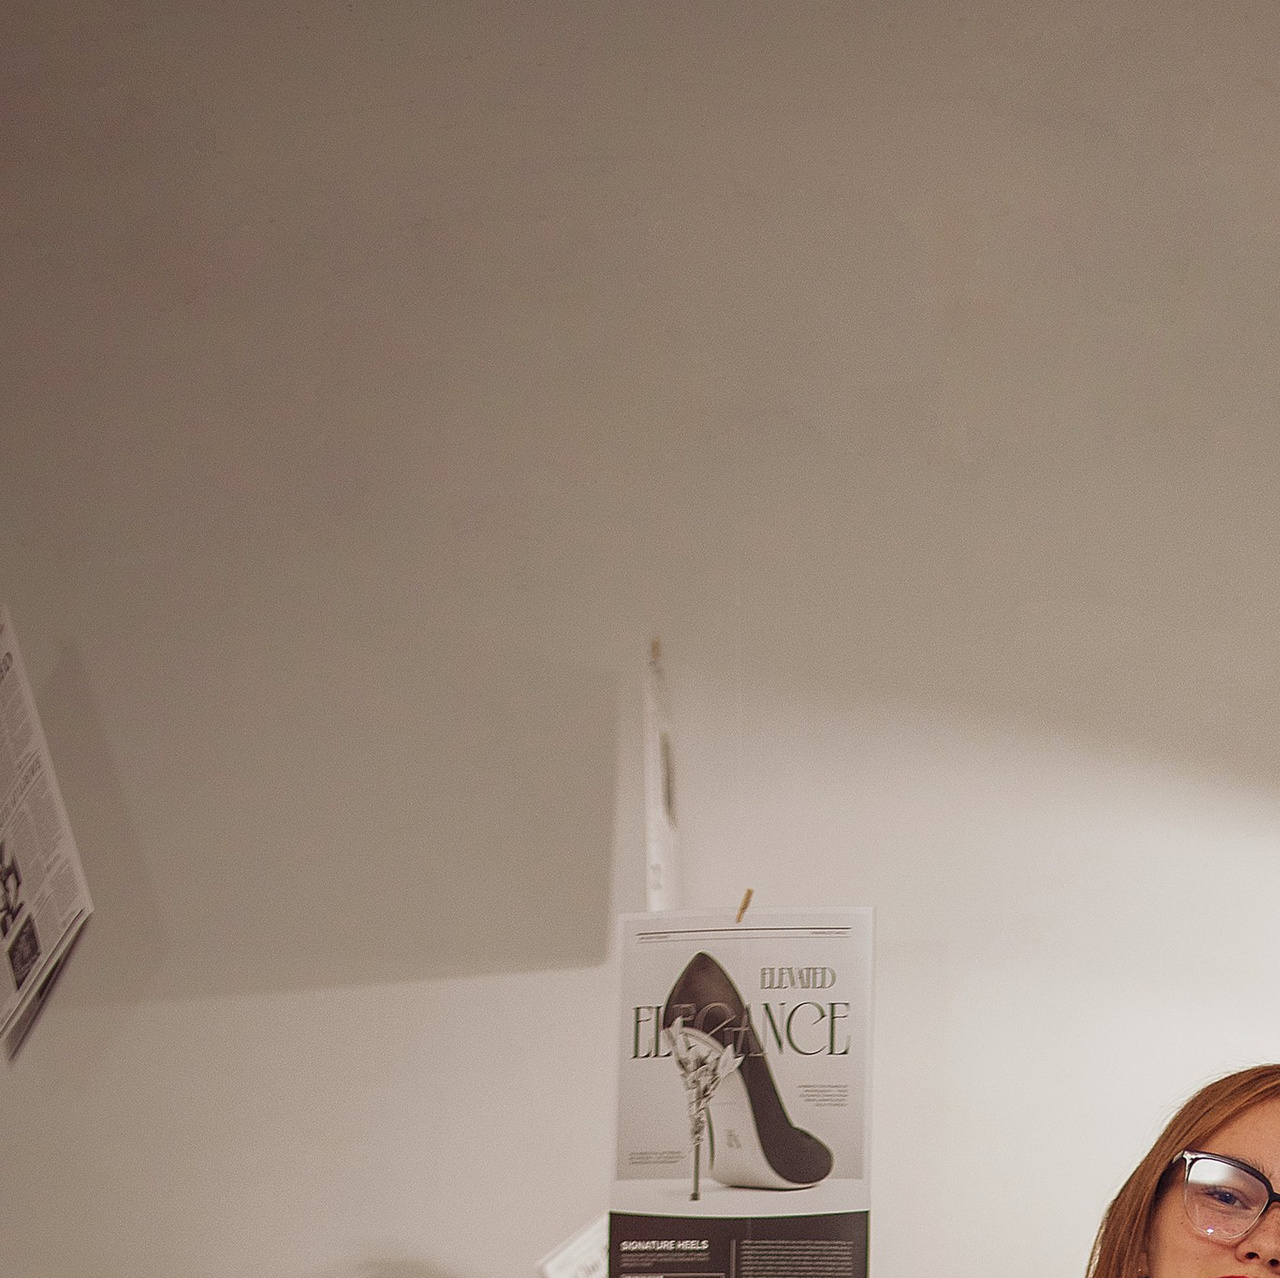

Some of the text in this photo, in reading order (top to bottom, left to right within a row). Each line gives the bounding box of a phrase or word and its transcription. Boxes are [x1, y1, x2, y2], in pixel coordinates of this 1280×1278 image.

[760, 967, 837, 990] ELEVATED
[621, 1240, 709, 1250] SIGNATURE HEELS
